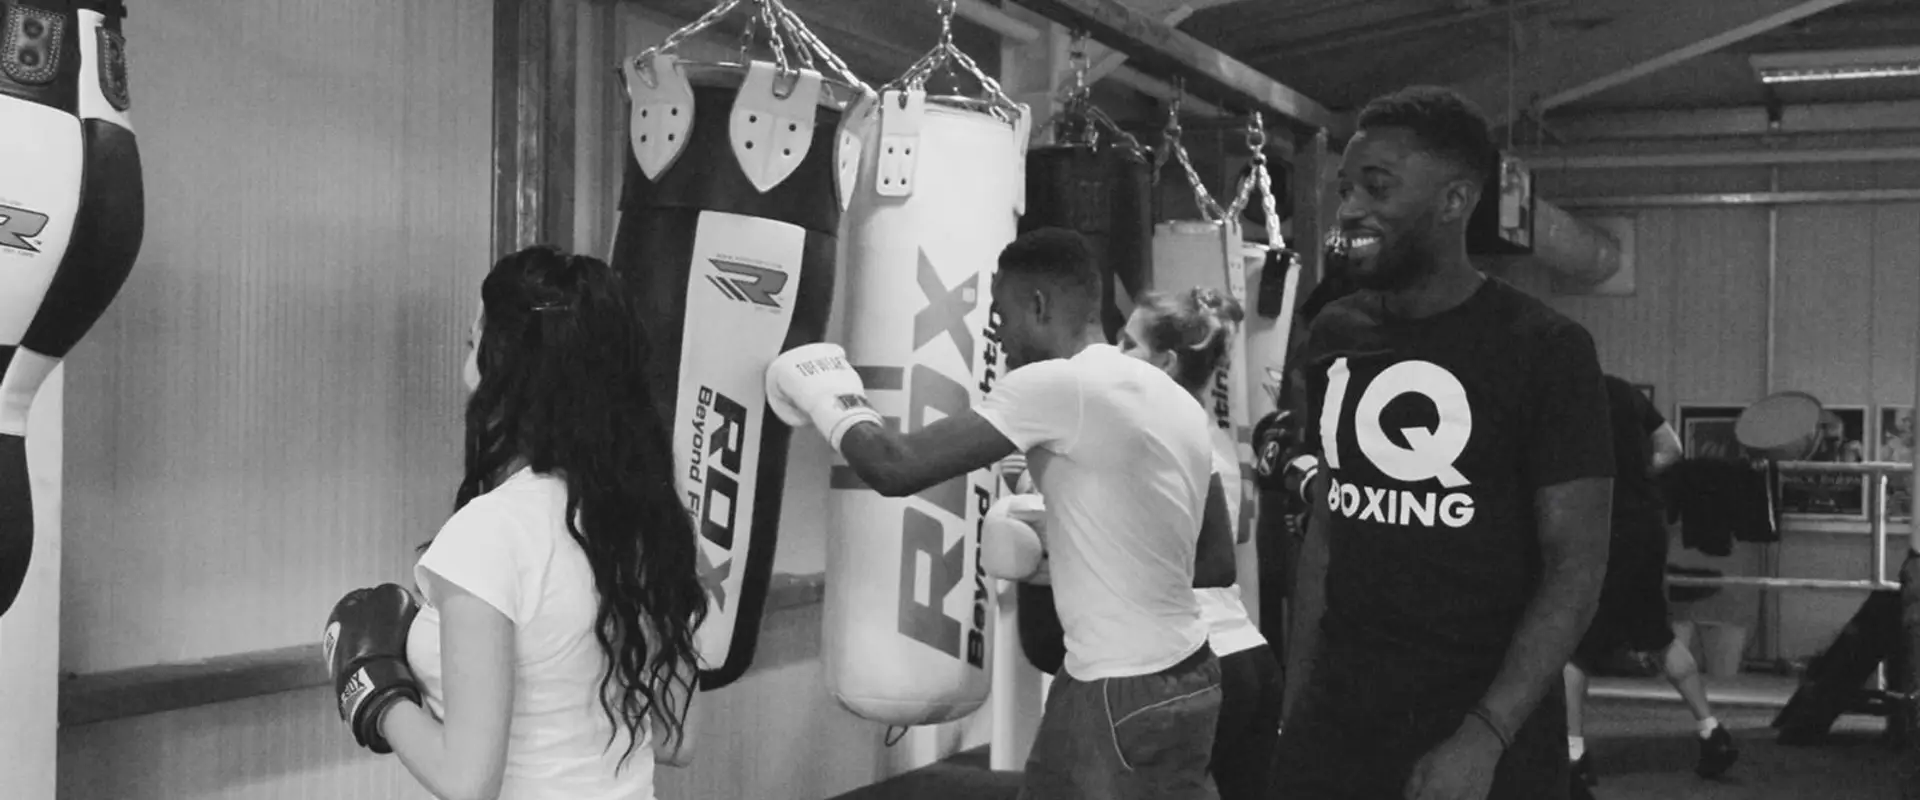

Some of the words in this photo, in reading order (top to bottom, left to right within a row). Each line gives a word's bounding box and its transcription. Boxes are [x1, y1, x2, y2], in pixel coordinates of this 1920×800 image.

[689, 384, 713, 484] Beyond
[1320, 357, 1473, 488] IQ
[697, 391, 747, 614] RDX
[1327, 478, 1475, 528] BOXING
